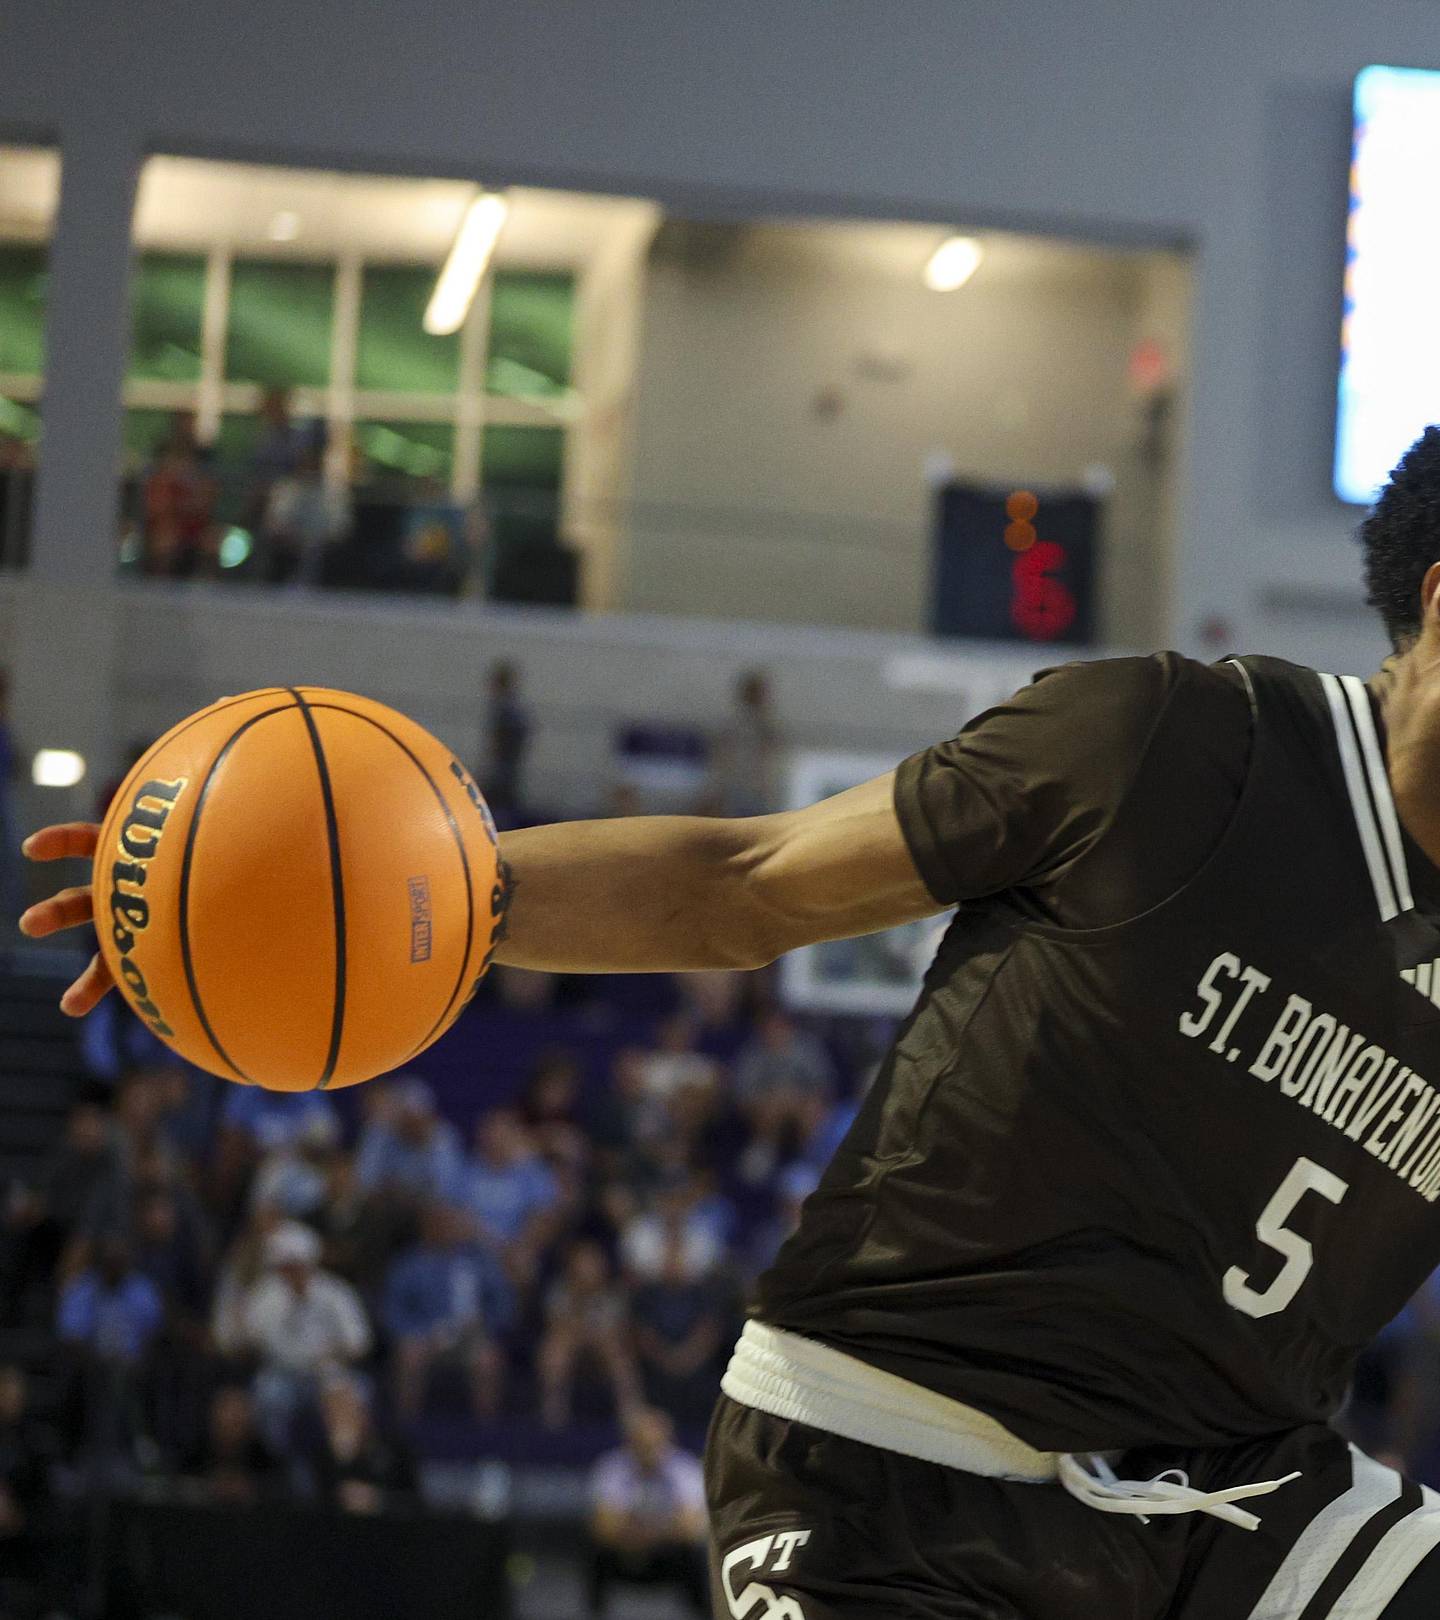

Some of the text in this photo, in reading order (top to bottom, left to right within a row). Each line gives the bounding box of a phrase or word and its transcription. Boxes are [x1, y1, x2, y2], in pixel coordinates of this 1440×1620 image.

[109, 776, 189, 1038] Wilson
[1179, 951, 1272, 1063] ST.
[1222, 1156, 1350, 1319] 5
